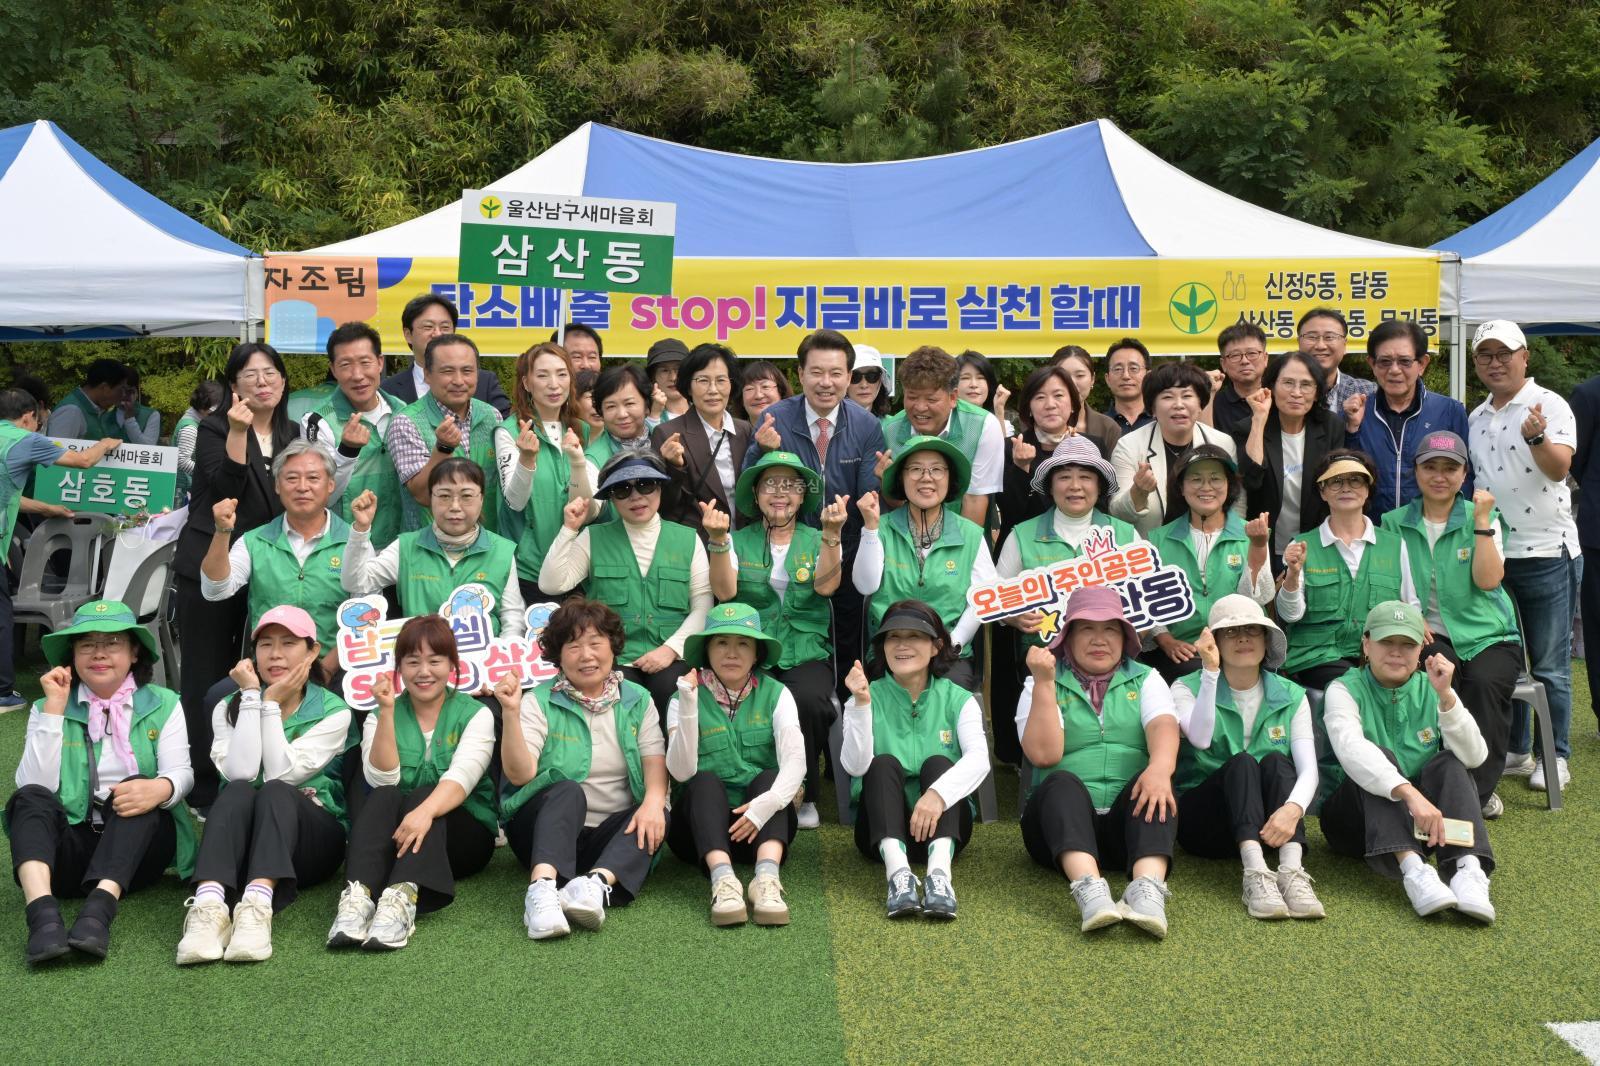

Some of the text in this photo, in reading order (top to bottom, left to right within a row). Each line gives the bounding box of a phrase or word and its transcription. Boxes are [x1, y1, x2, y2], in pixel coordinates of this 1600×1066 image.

[507, 199, 654, 226] 울산남구새마을회
[491, 234, 645, 284] 삼산동
[265, 265, 366, 298] 자조팀
[1264, 271, 1389, 300] 신정5동, 달동
[630, 285, 767, 341] stop!
[1050, 284, 1140, 329] 할때
[68, 444, 163, 466] 구새마을회
[58, 471, 151, 509] 삼호동
[973, 546, 1153, 617] 오늘의 주인공은
